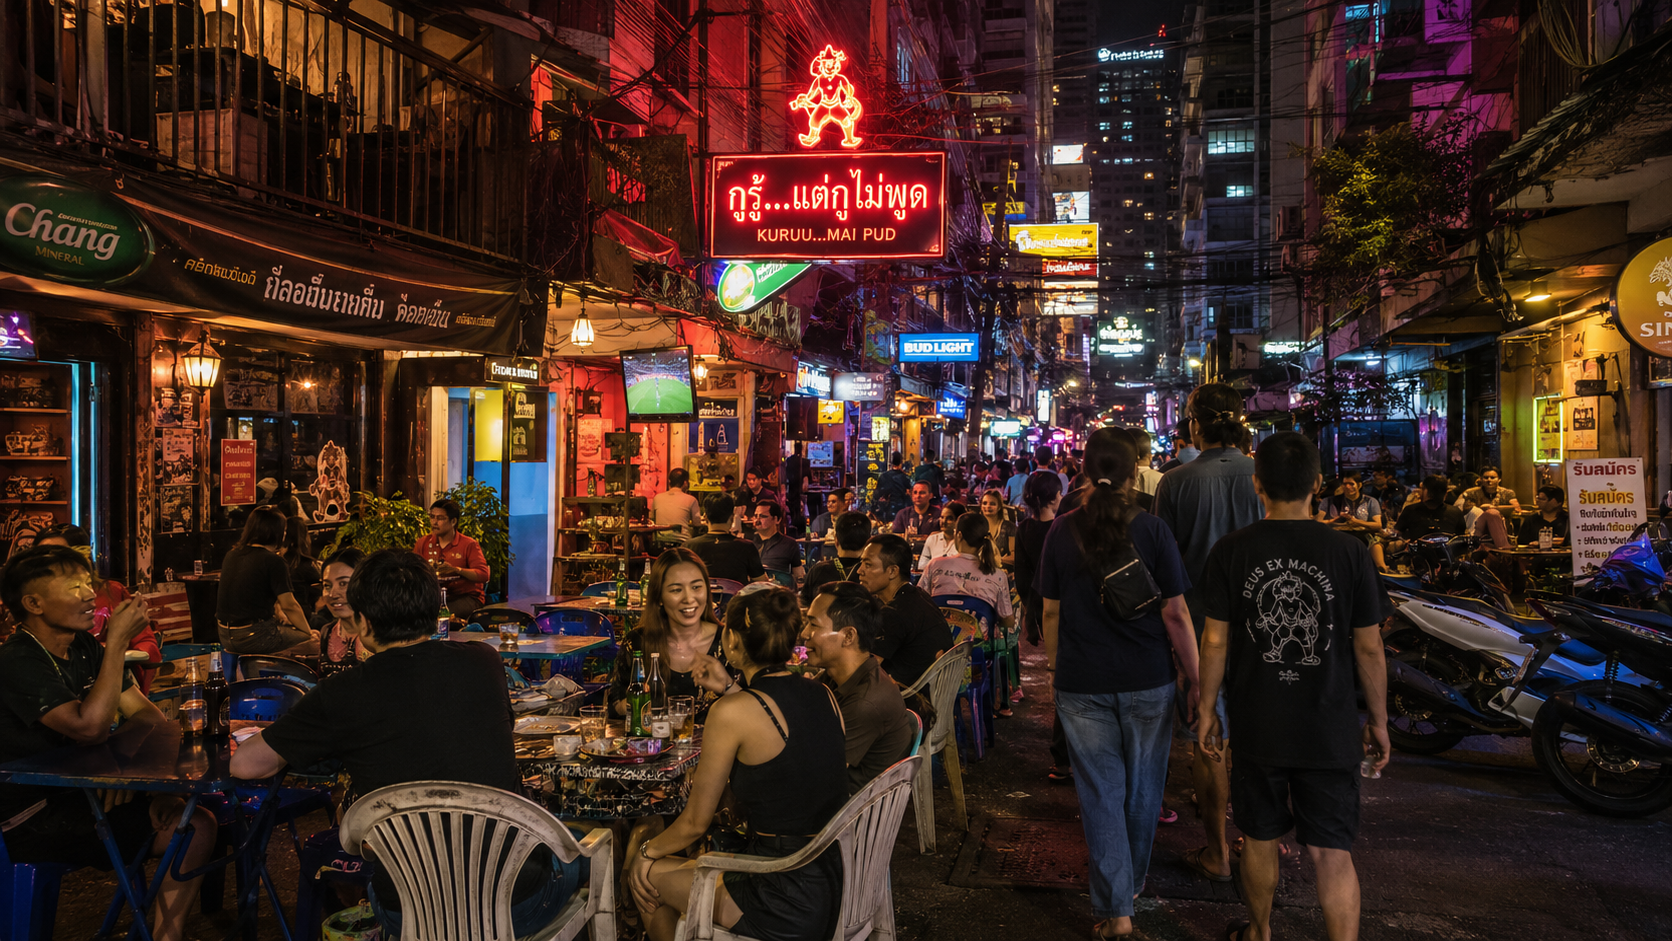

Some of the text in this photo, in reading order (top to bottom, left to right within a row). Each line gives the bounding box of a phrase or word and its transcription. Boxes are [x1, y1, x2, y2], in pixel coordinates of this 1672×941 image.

[728, 168, 929, 222] กูรู้...แต่กูไม่พูด
[4, 202, 121, 261] Chang
[757, 228, 897, 242] KURUU...MAI PUD
[35, 245, 85, 266] MINERAL
[904, 342, 975, 353] BUD LIGHT
[1242, 558, 1335, 602] DEUS EX MACHINA
